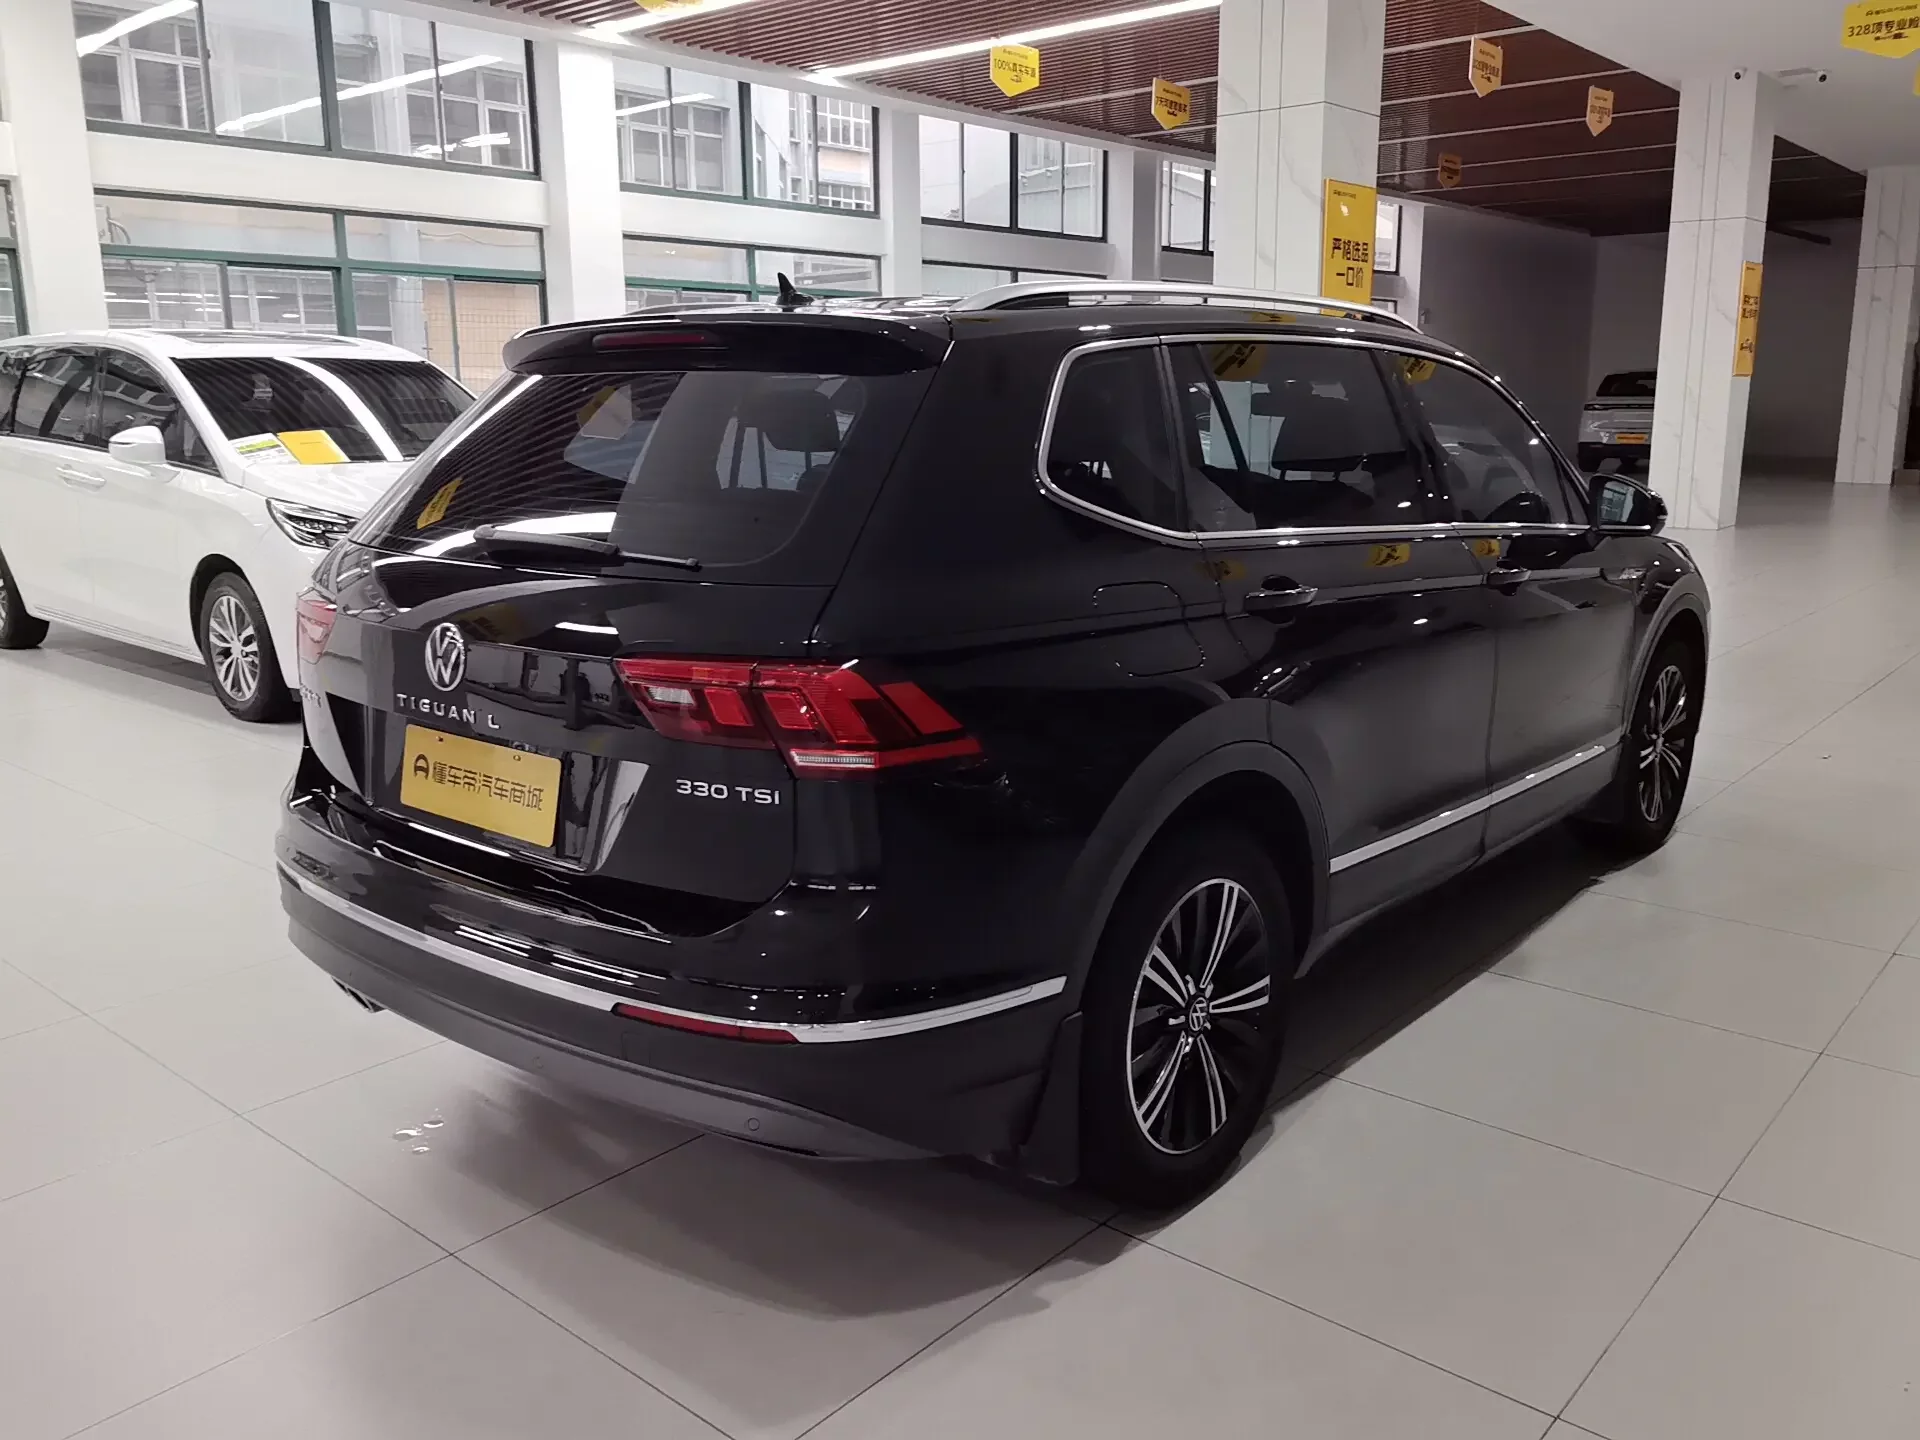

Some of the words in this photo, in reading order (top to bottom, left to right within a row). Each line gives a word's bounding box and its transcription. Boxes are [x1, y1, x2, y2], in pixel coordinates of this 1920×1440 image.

[1331, 237, 1369, 263] 严格选品
[1335, 266, 1364, 289] 一口价
[396, 693, 476, 724] TIGUAN
[487, 714, 501, 730] L
[432, 760, 545, 812] 懂车帝汽车商城
[676, 779, 729, 799] 330
[734, 786, 780, 805] TSI
